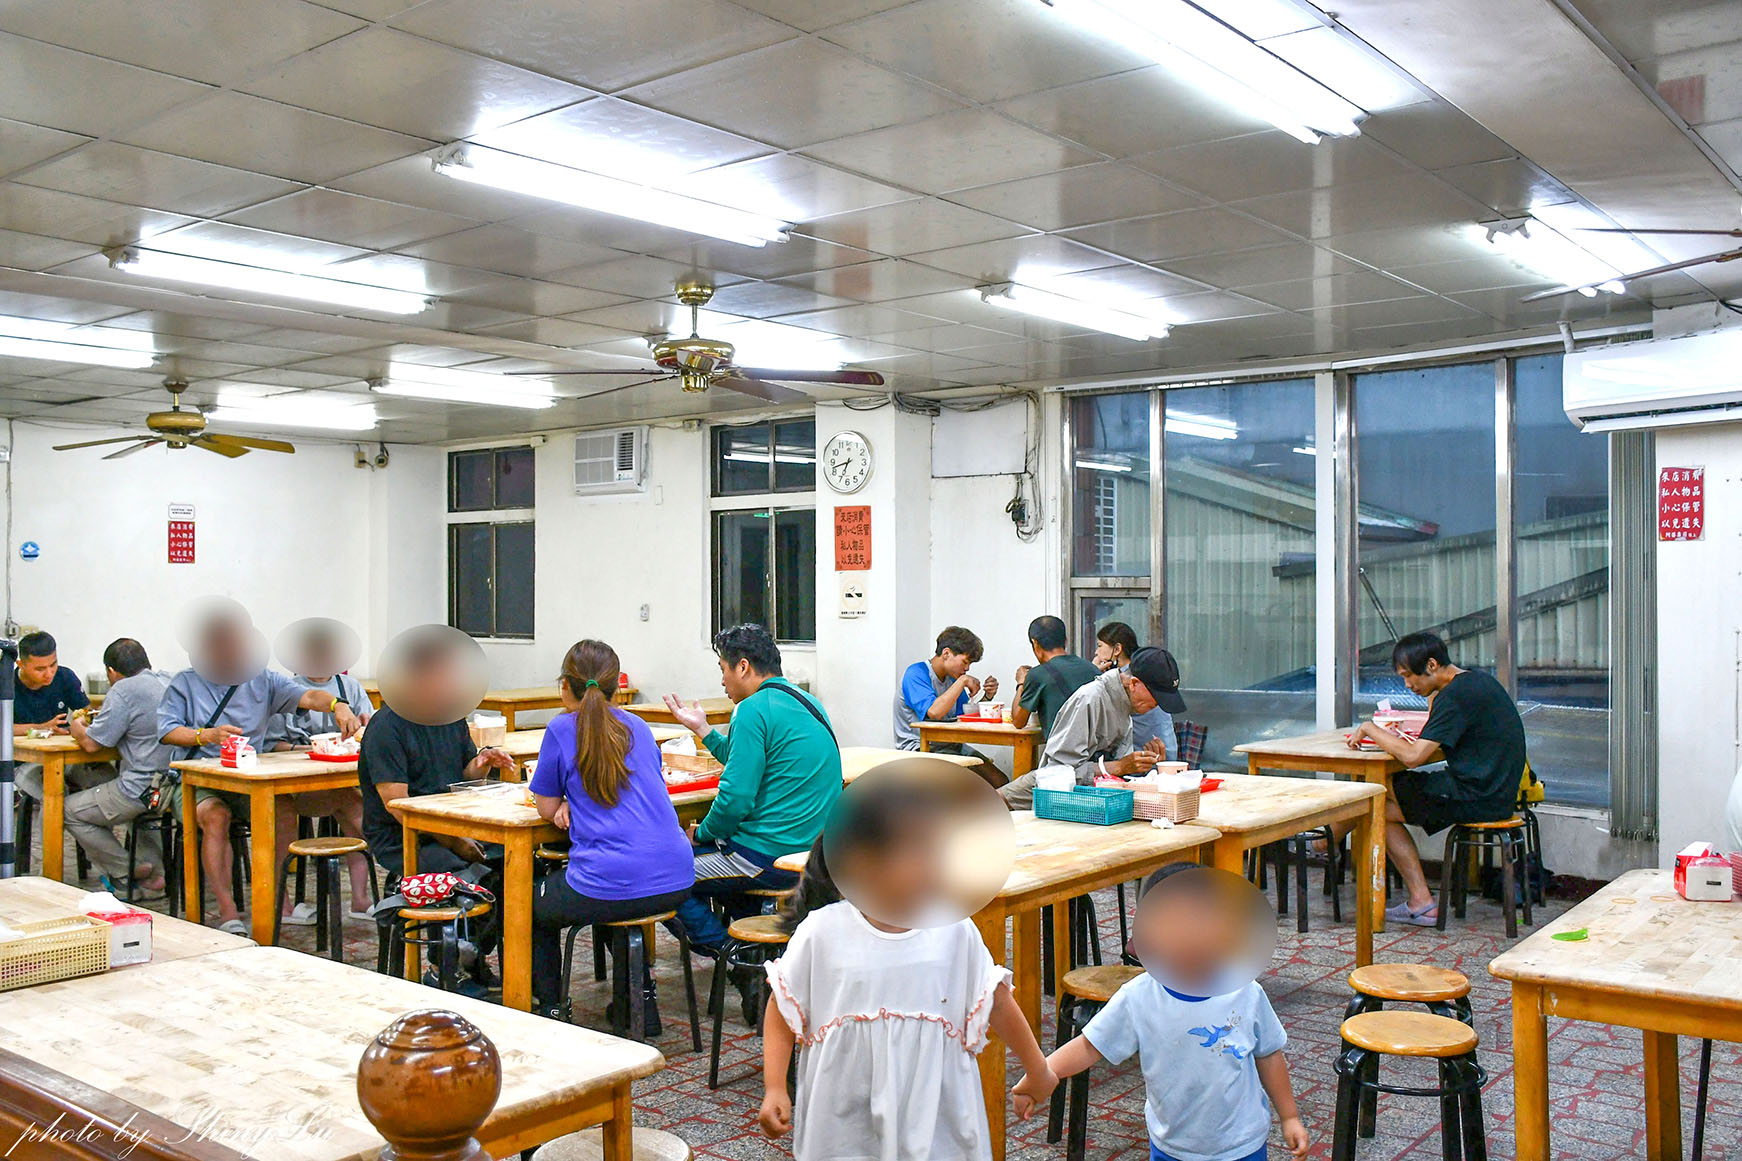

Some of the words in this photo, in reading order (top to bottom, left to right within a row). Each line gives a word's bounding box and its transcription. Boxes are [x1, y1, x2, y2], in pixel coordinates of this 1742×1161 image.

[832, 448, 840, 456] 10
[830, 458, 836, 466] 9
[862, 458, 867, 466] 3
[832, 468, 837, 476] 8
[844, 478, 850, 486] 6
[852, 476, 858, 484] 5
[1662, 486, 1700, 498] 私人物品
[1662, 502, 1700, 514] 小心保管
